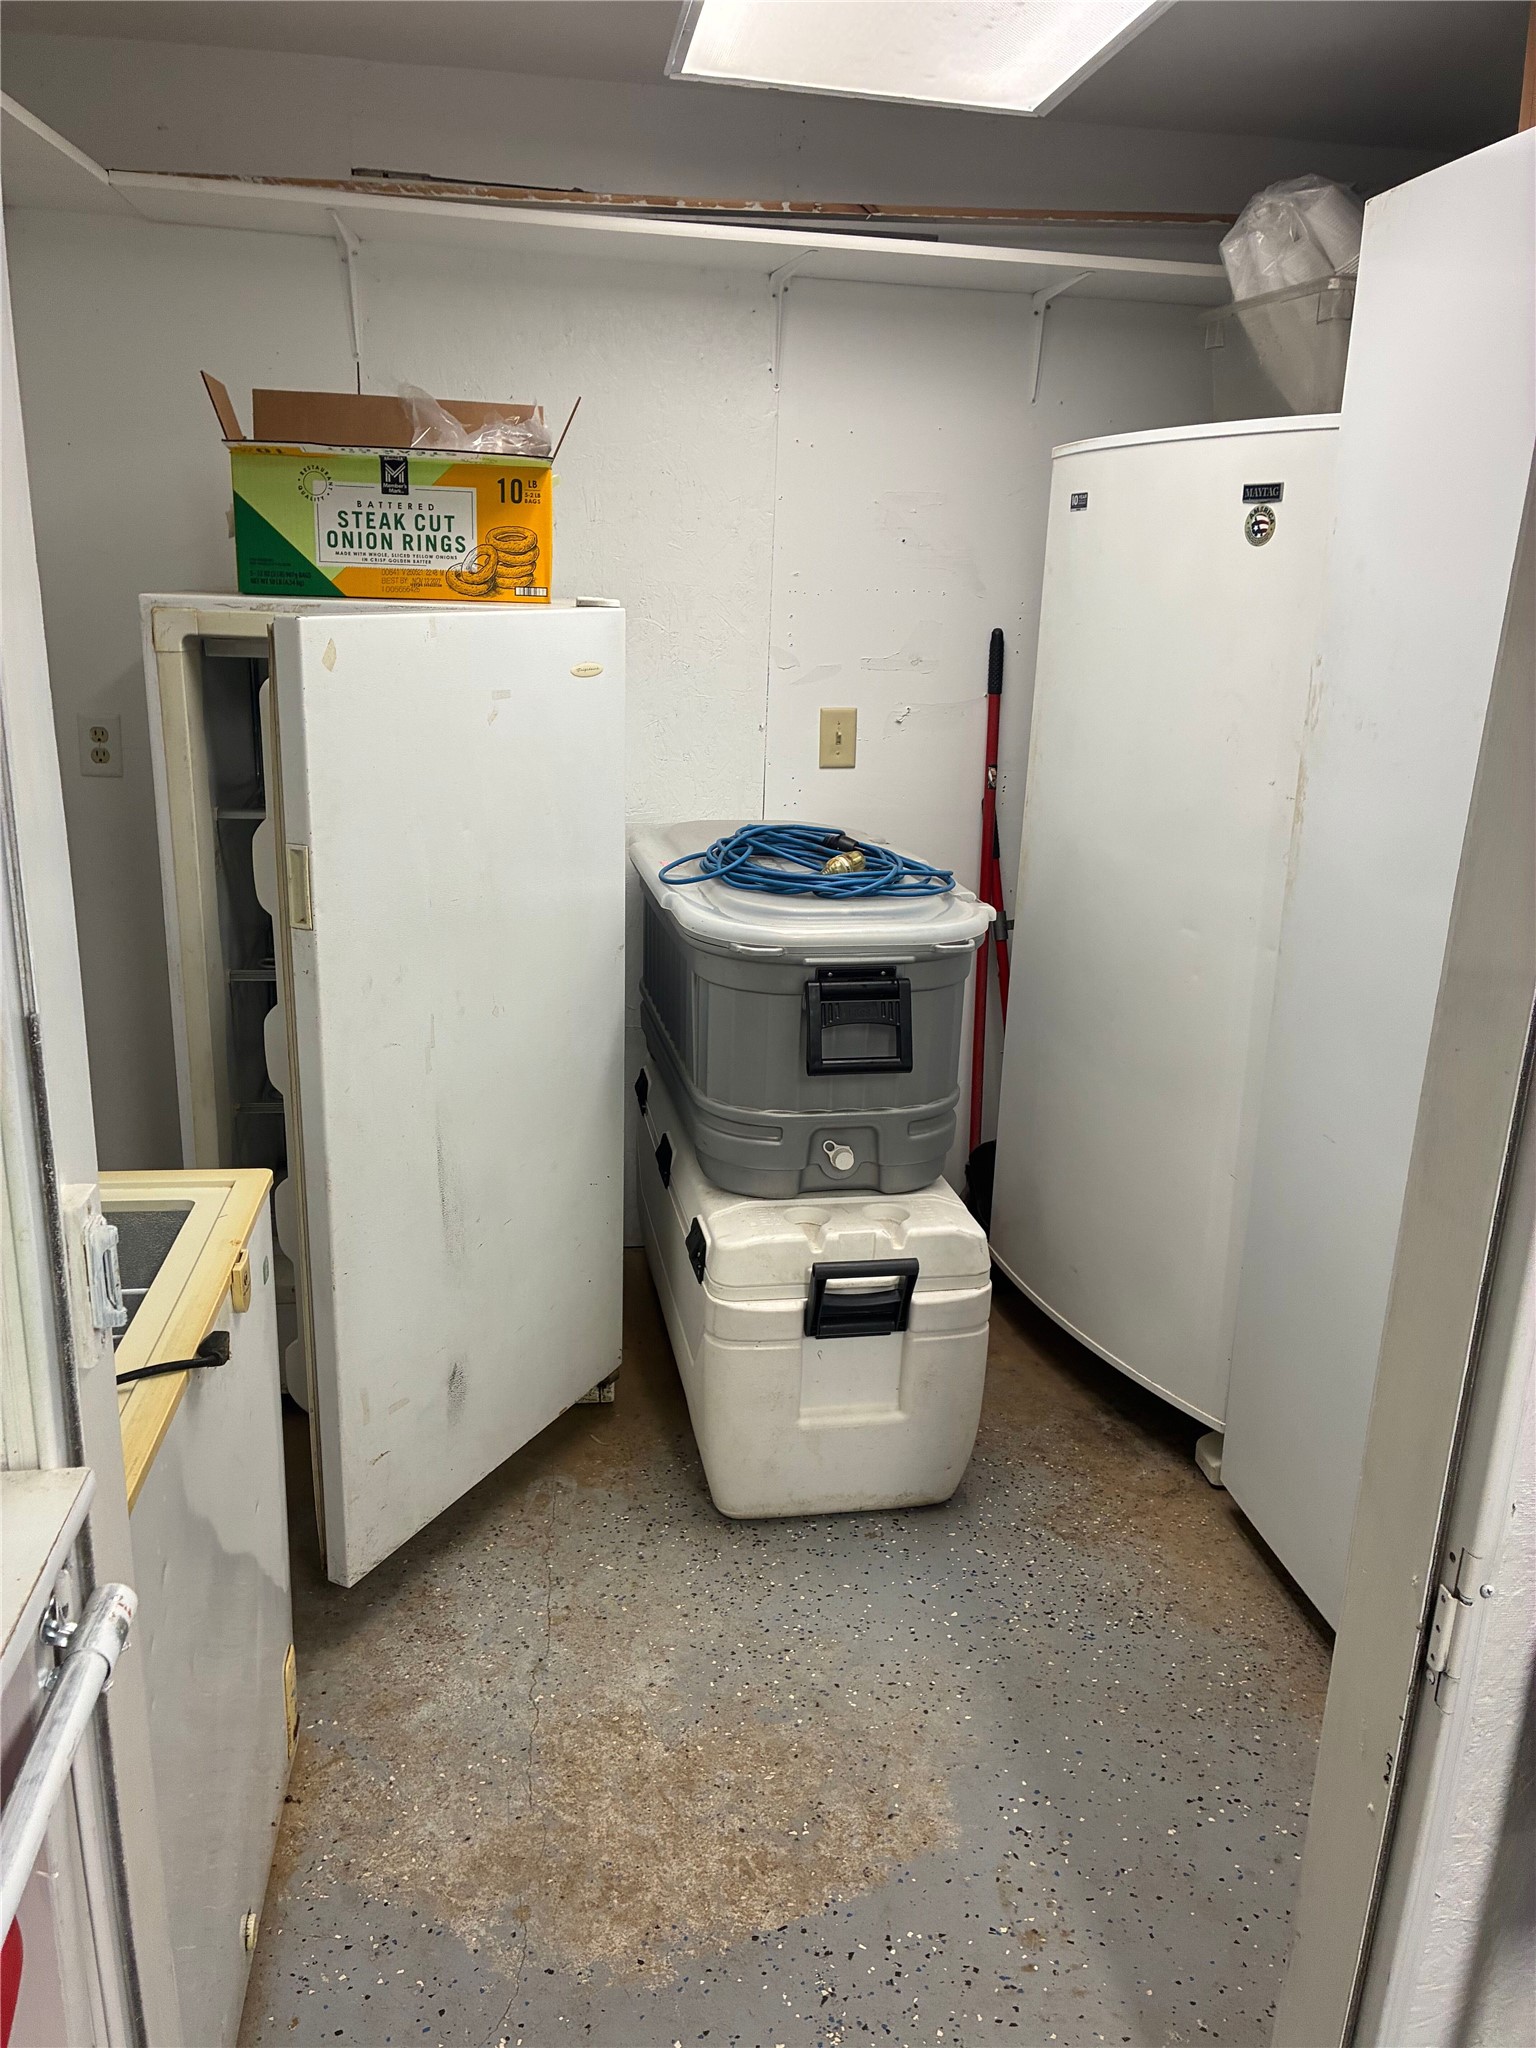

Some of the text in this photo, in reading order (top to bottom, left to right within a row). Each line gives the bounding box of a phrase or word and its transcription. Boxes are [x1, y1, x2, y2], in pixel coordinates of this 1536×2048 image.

[299, 465, 333, 491] RESTAURANT
[298, 485, 325, 502] QUALITY
[497, 477, 538, 504] 10 LB
[1244, 487, 1280, 498] MAYTAG
[356, 500, 435, 511] BATTERED
[337, 510, 455, 533] STEAK CUT
[1249, 506, 1275, 525] AMERICA
[326, 530, 466, 553] ONION RINGS
[381, 577, 399, 585] BEST
